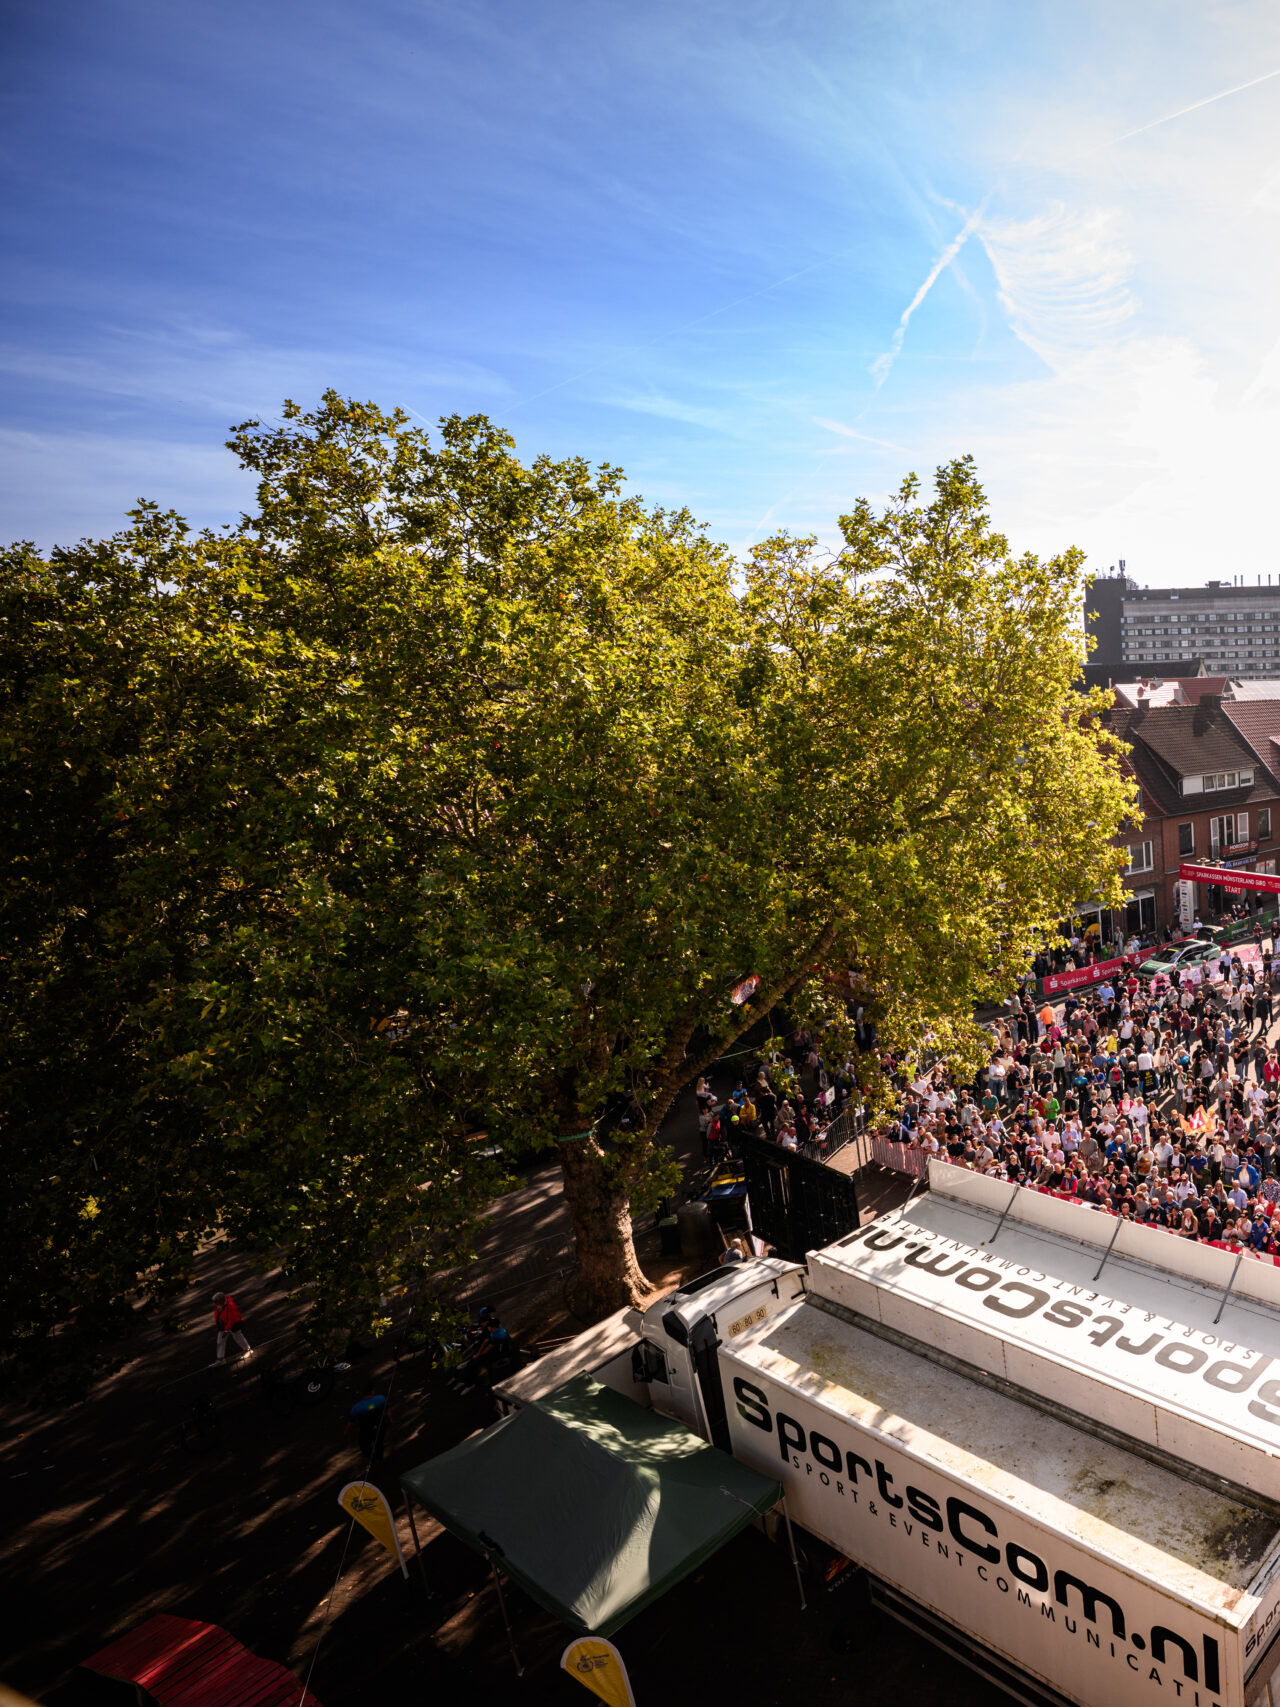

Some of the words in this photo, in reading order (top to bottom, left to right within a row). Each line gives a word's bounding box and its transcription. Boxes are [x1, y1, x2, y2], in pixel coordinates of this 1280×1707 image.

[1196, 871, 1222, 881] SPARKASSEN
[1223, 874, 1255, 886] MÜNSTERLAND
[1255, 879, 1267, 887] GIRO
[1224, 885, 1241, 894] START
[1060, 974, 1088, 987] Sparkasse
[1162, 1319, 1259, 1360] SPORT
[792, 1455, 859, 1503] SPORT
[868, 1501, 879, 1517] &
[733, 1376, 1221, 1695] SportsCom.nl
